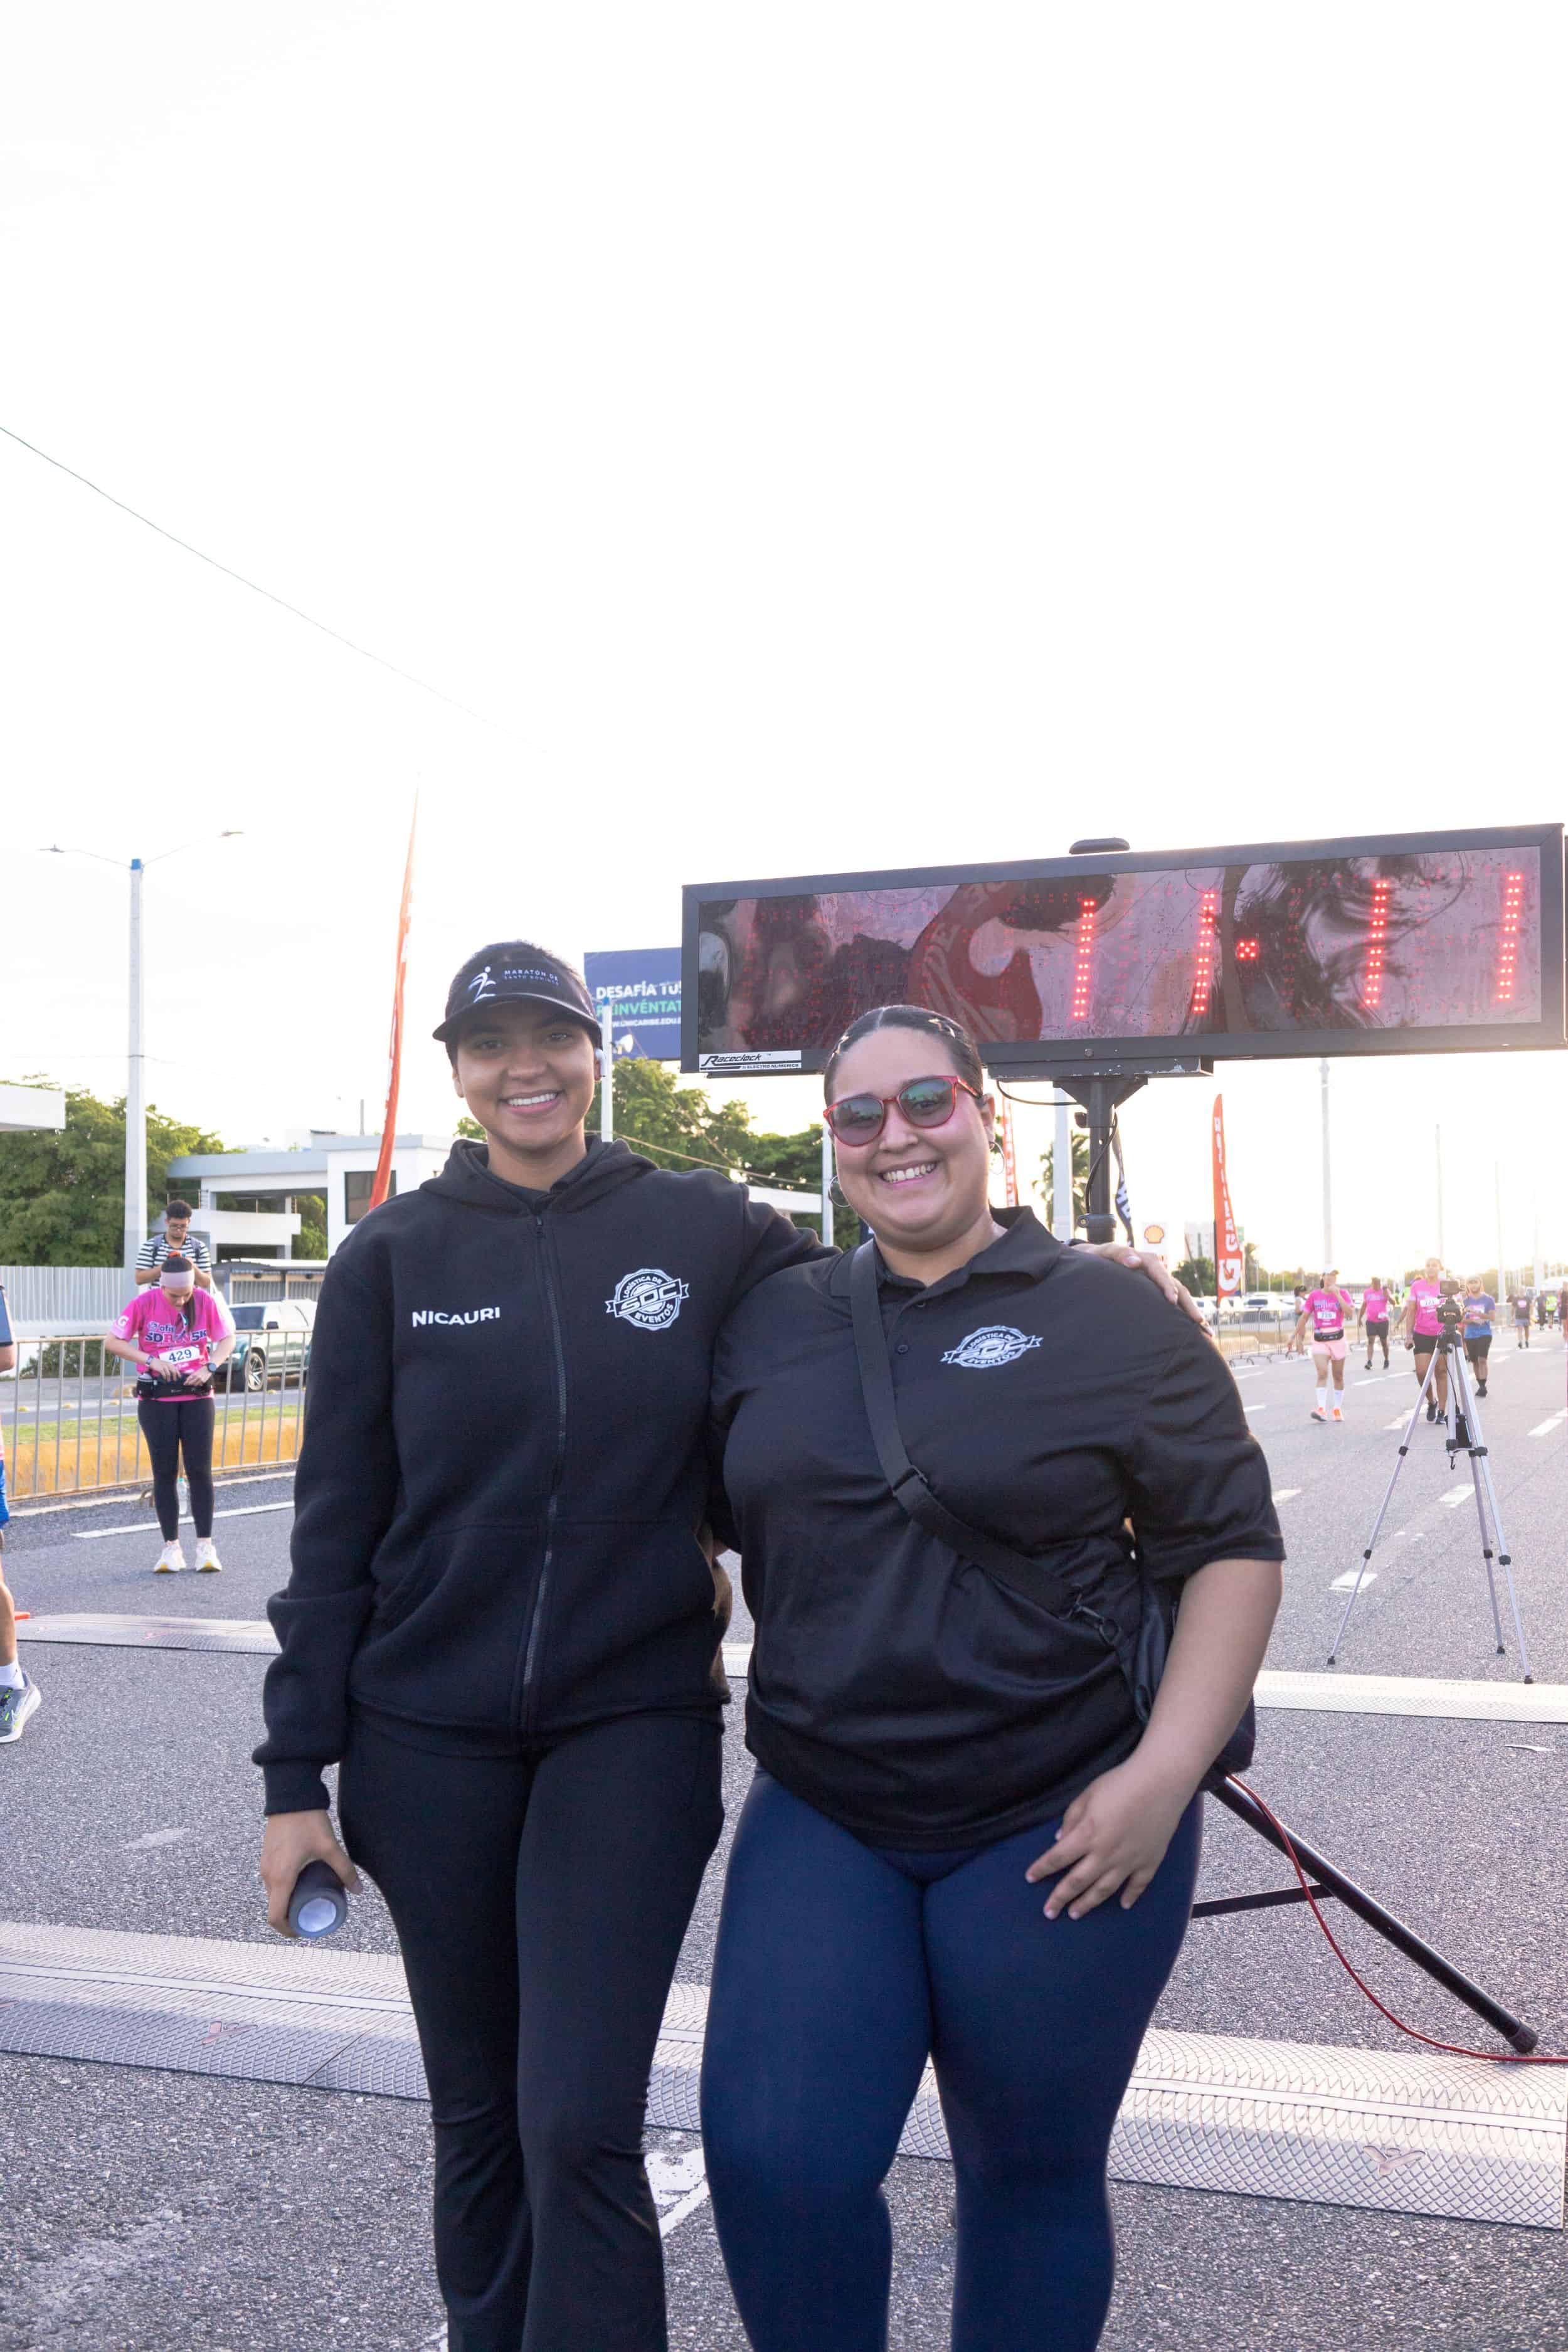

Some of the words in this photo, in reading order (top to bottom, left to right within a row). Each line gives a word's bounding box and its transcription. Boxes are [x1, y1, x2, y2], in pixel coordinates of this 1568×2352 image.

[596, 980, 657, 999] DESAFÍA
[701, 1054, 762, 1066] Raceclock
[412, 1306, 500, 1328] NICAURI
[634, 1303, 674, 1323] EVENTOS
[191, 1330, 207, 1342] 5K
[169, 1349, 192, 1362] 429
